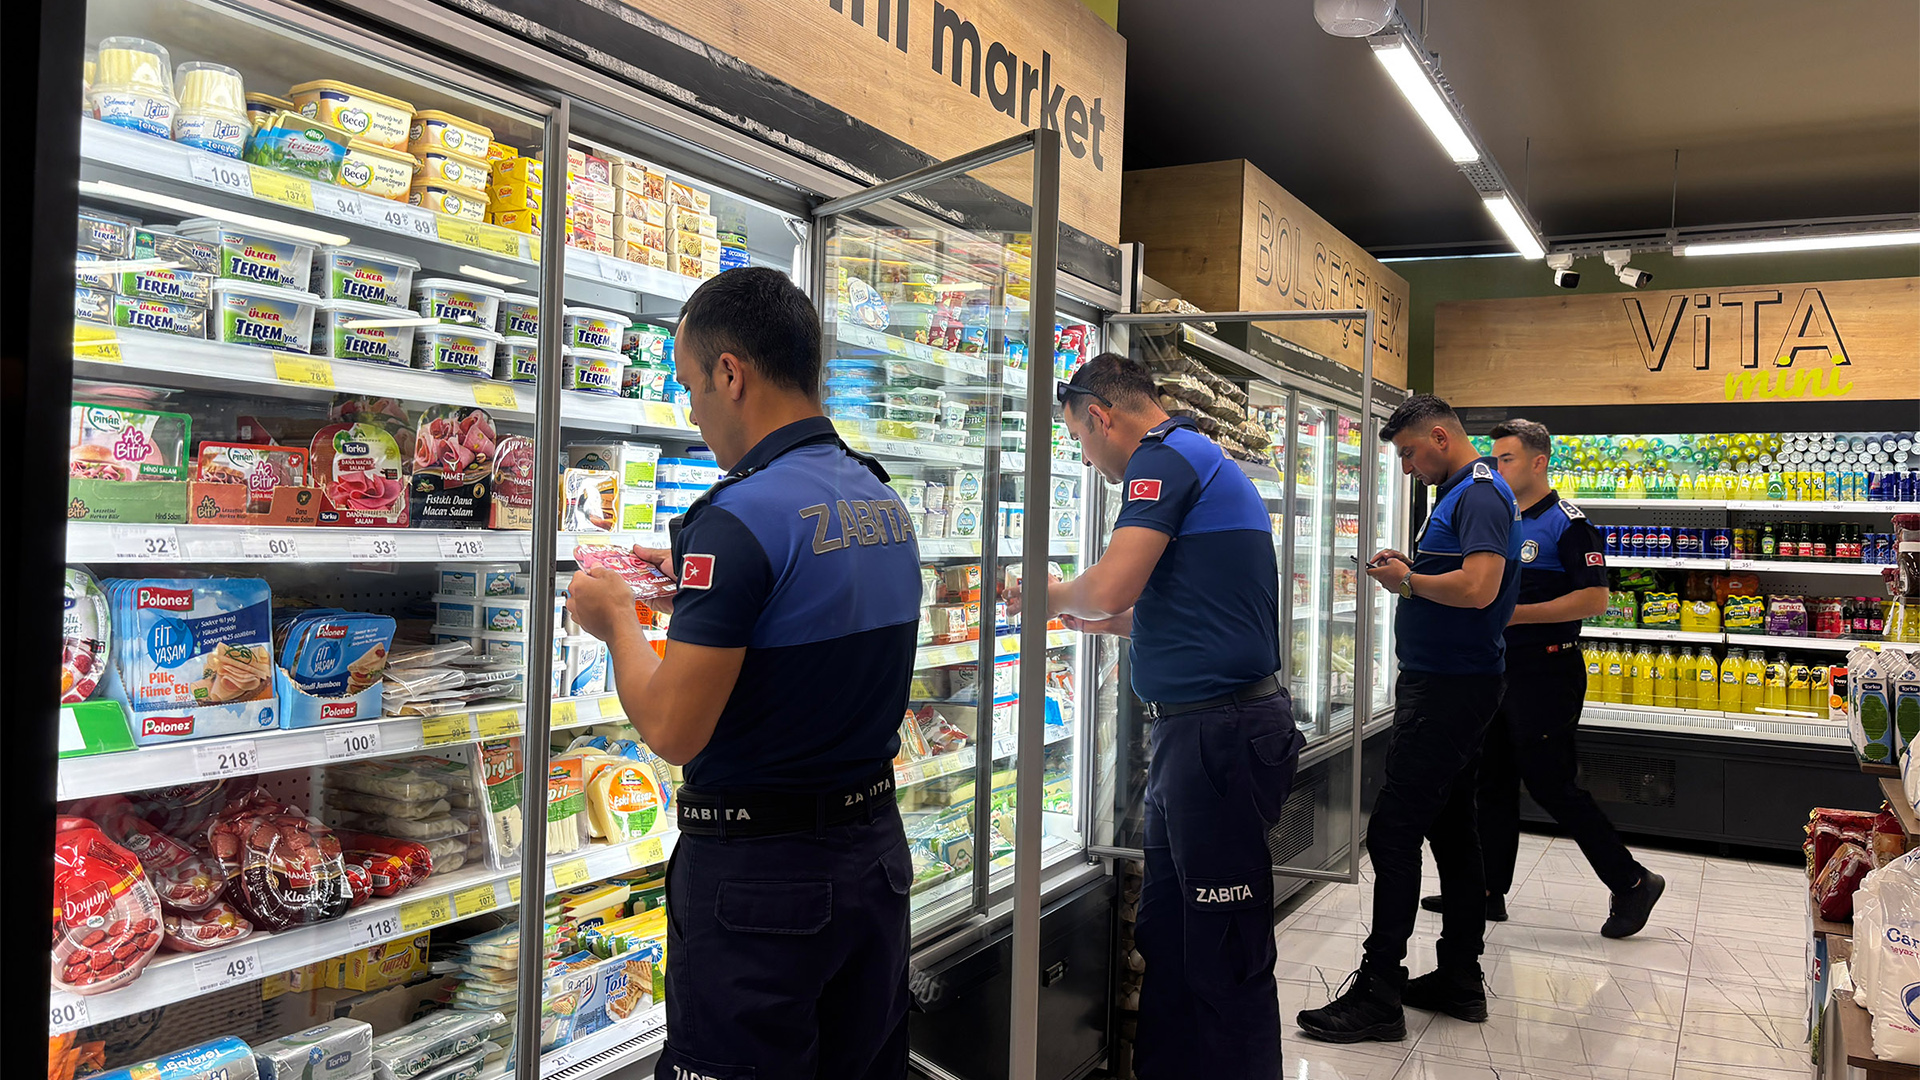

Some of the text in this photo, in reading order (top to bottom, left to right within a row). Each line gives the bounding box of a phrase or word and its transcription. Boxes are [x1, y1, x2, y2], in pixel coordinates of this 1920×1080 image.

[932, 0, 1105, 171] market
[144, 98, 169, 120] İçim
[342, 113, 366, 128] Becel
[213, 120, 240, 140] İçim
[211, 166, 240, 188] 109
[344, 168, 368, 182] Becel
[337, 199, 354, 215] 94
[385, 211, 401, 225] 49
[244, 246, 277, 262] ÜLKER
[597, 242, 612, 254] Sana
[231, 257, 280, 281] TEREM
[355, 269, 383, 282] ÜLKER
[136, 276, 180, 295] TEREM
[1256, 200, 1401, 357] BOL SEÇENEK
[343, 279, 385, 300] TEREM
[139, 302, 169, 314] ÜLKER
[448, 297, 474, 308] ÜLKER
[128, 310, 173, 329] TEREM
[249, 307, 280, 321] ÜLKER
[436, 304, 477, 320] TEREM
[236, 319, 282, 342] TEREM
[510, 317, 538, 334] TERE
[588, 325, 608, 333] ÜLKER
[578, 329, 610, 344] TEREM
[344, 336, 387, 355] TEREM
[452, 342, 476, 352] ÜLKER
[439, 349, 479, 366] TEREM
[590, 365, 610, 373] ÜLKER
[580, 370, 611, 384] TEREM
[1725, 354, 1853, 400] mini
[117, 442, 150, 460] Bitir
[345, 445, 366, 453] Torku
[158, 466, 177, 475] SALAM
[441, 472, 465, 481] NAMET
[252, 475, 276, 488] Bitir
[453, 496, 473, 505] Dana
[321, 513, 338, 521] Torku
[423, 507, 473, 517] Macar Salam
[799, 499, 915, 555] ZABITA
[146, 538, 167, 553] 32
[269, 539, 288, 554] 60
[374, 541, 390, 553] 33
[455, 541, 477, 554] 218
[140, 590, 191, 606] Polonez
[154, 625, 170, 647] FİT
[317, 626, 346, 638] Polonez
[155, 644, 186, 664] YAŞAM
[149, 672, 174, 685] Piliç
[315, 681, 341, 690] Jambon
[140, 684, 189, 699] Füme Eti
[323, 705, 355, 717] Polonez
[145, 718, 191, 735] Polonez
[344, 736, 368, 752] 100
[218, 752, 249, 770] 218
[284, 890, 323, 902] Klasik
[1196, 884, 1253, 903] ZABITA
[64, 889, 111, 920] Doyum
[479, 897, 490, 906] 107
[367, 920, 391, 939] 118
[227, 961, 246, 978] 49
[605, 973, 628, 994] Tost
[52, 1004, 76, 1025] 80
[642, 1018, 656, 1026] 27
[327, 1054, 350, 1069] Torku
[552, 1056, 568, 1066] 27
